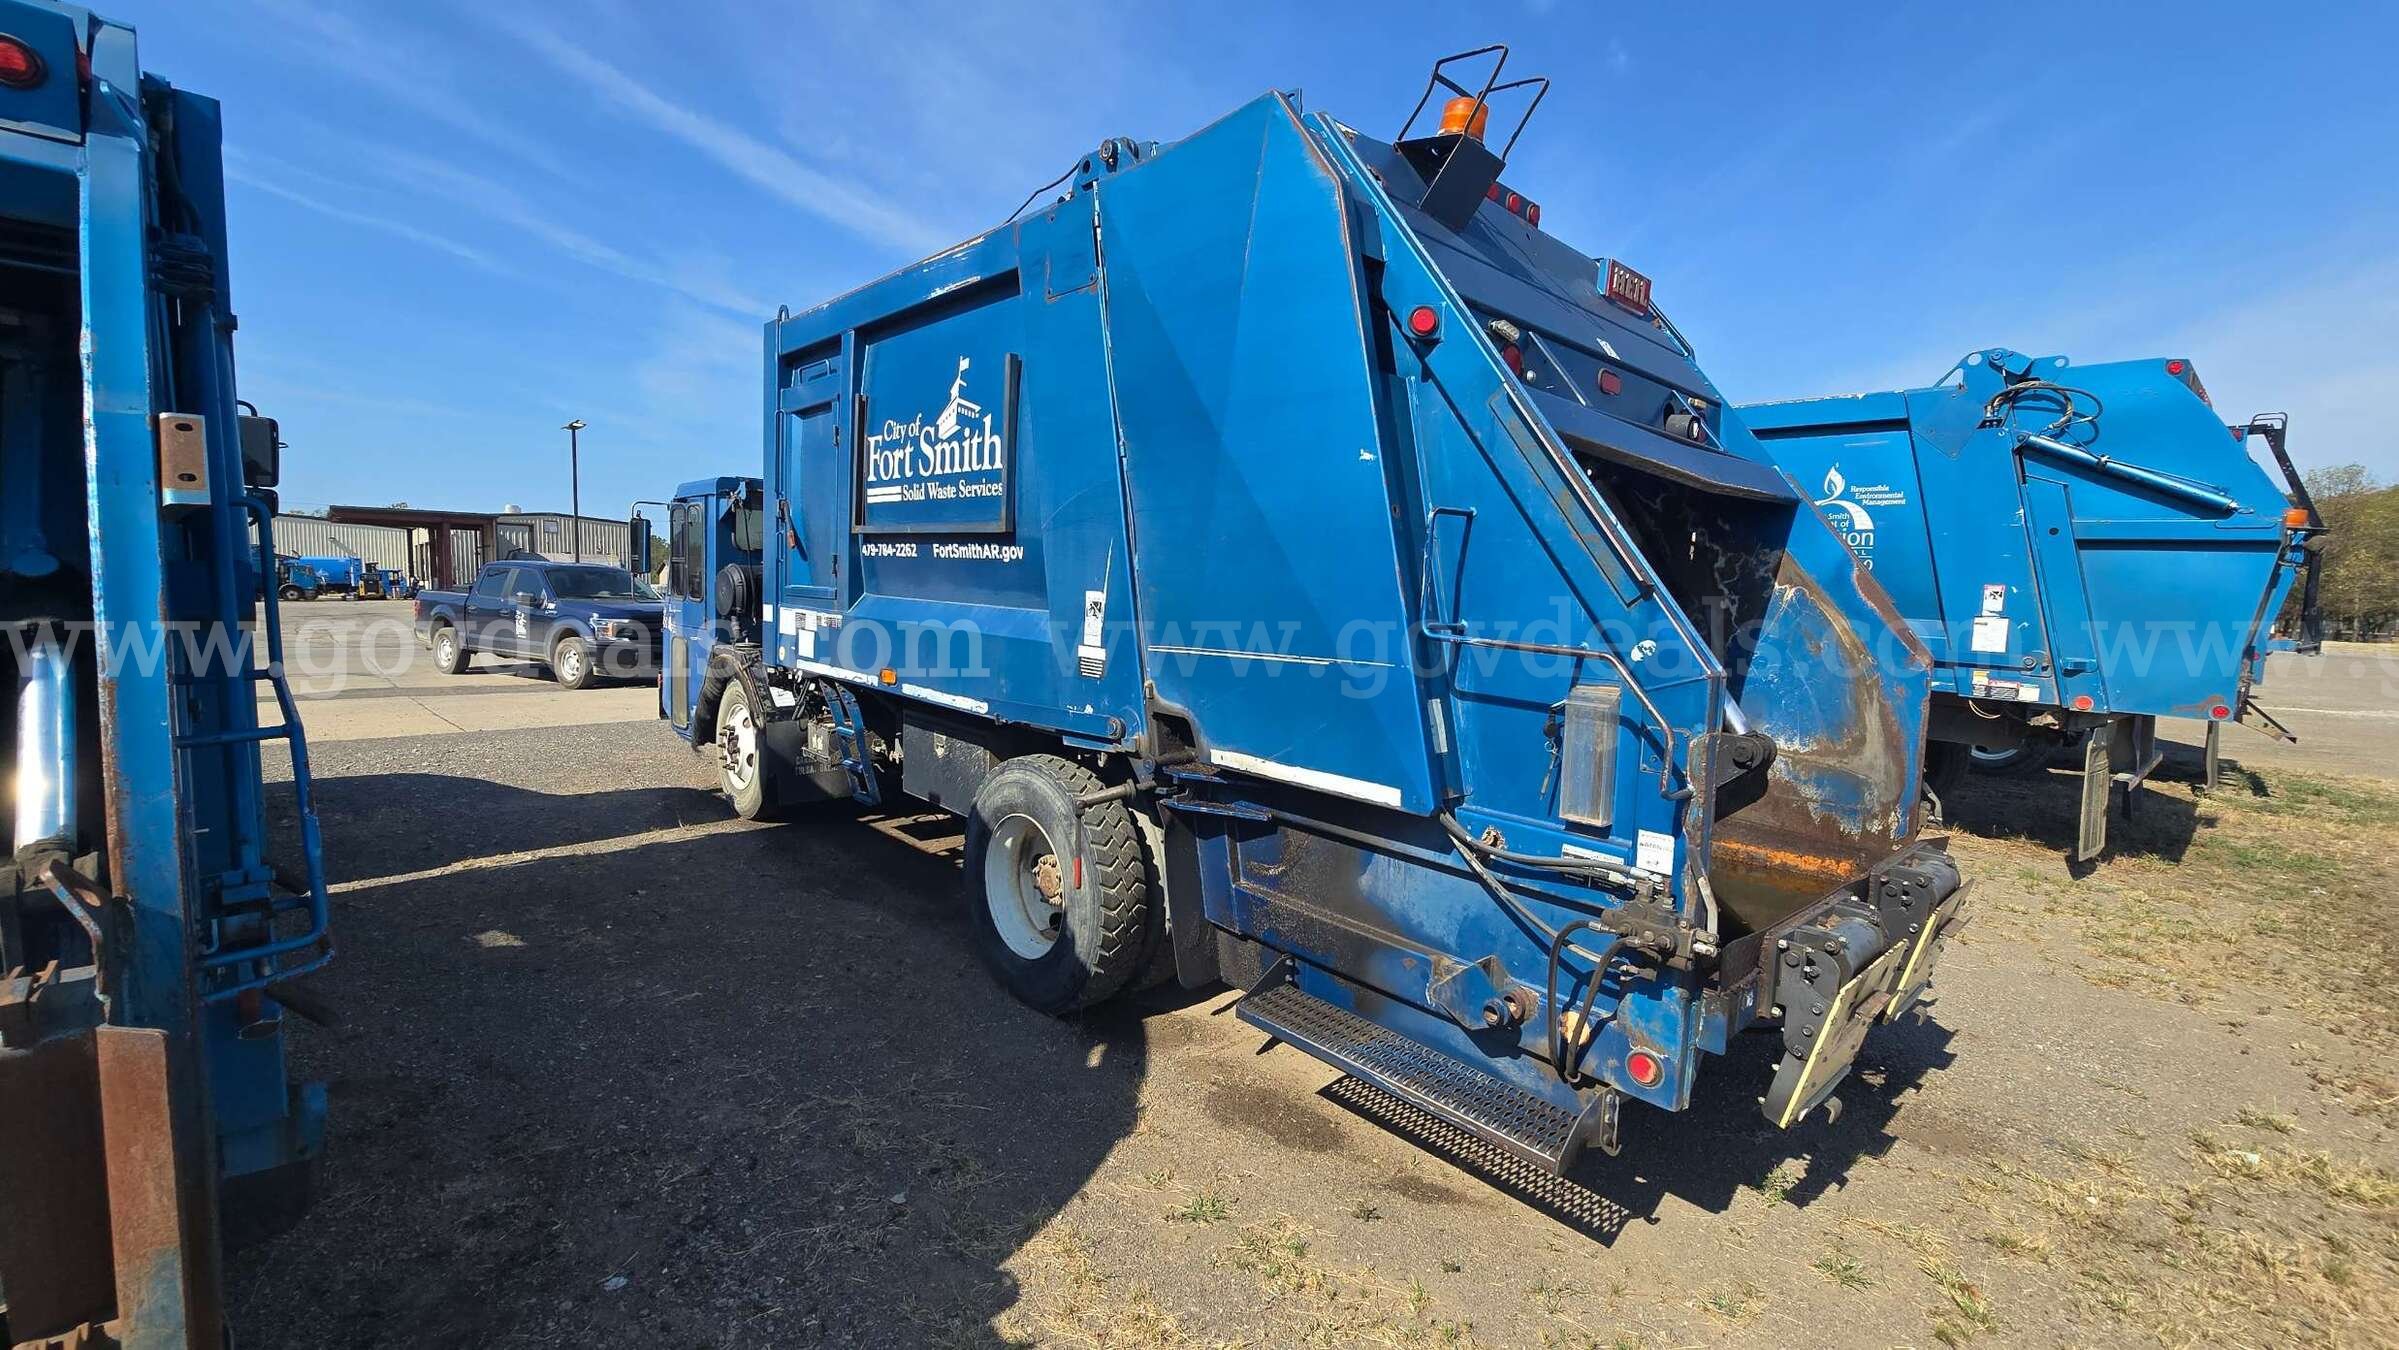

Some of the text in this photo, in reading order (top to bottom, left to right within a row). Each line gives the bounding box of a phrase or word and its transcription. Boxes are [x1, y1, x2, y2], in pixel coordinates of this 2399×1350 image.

[884, 413, 922, 444] City of
[867, 413, 1003, 481] Fort Smith
[903, 478, 1003, 501] Solid Waste Services
[1827, 512, 1850, 520] Smith
[932, 543, 1024, 563] FortSmithAR.gov
